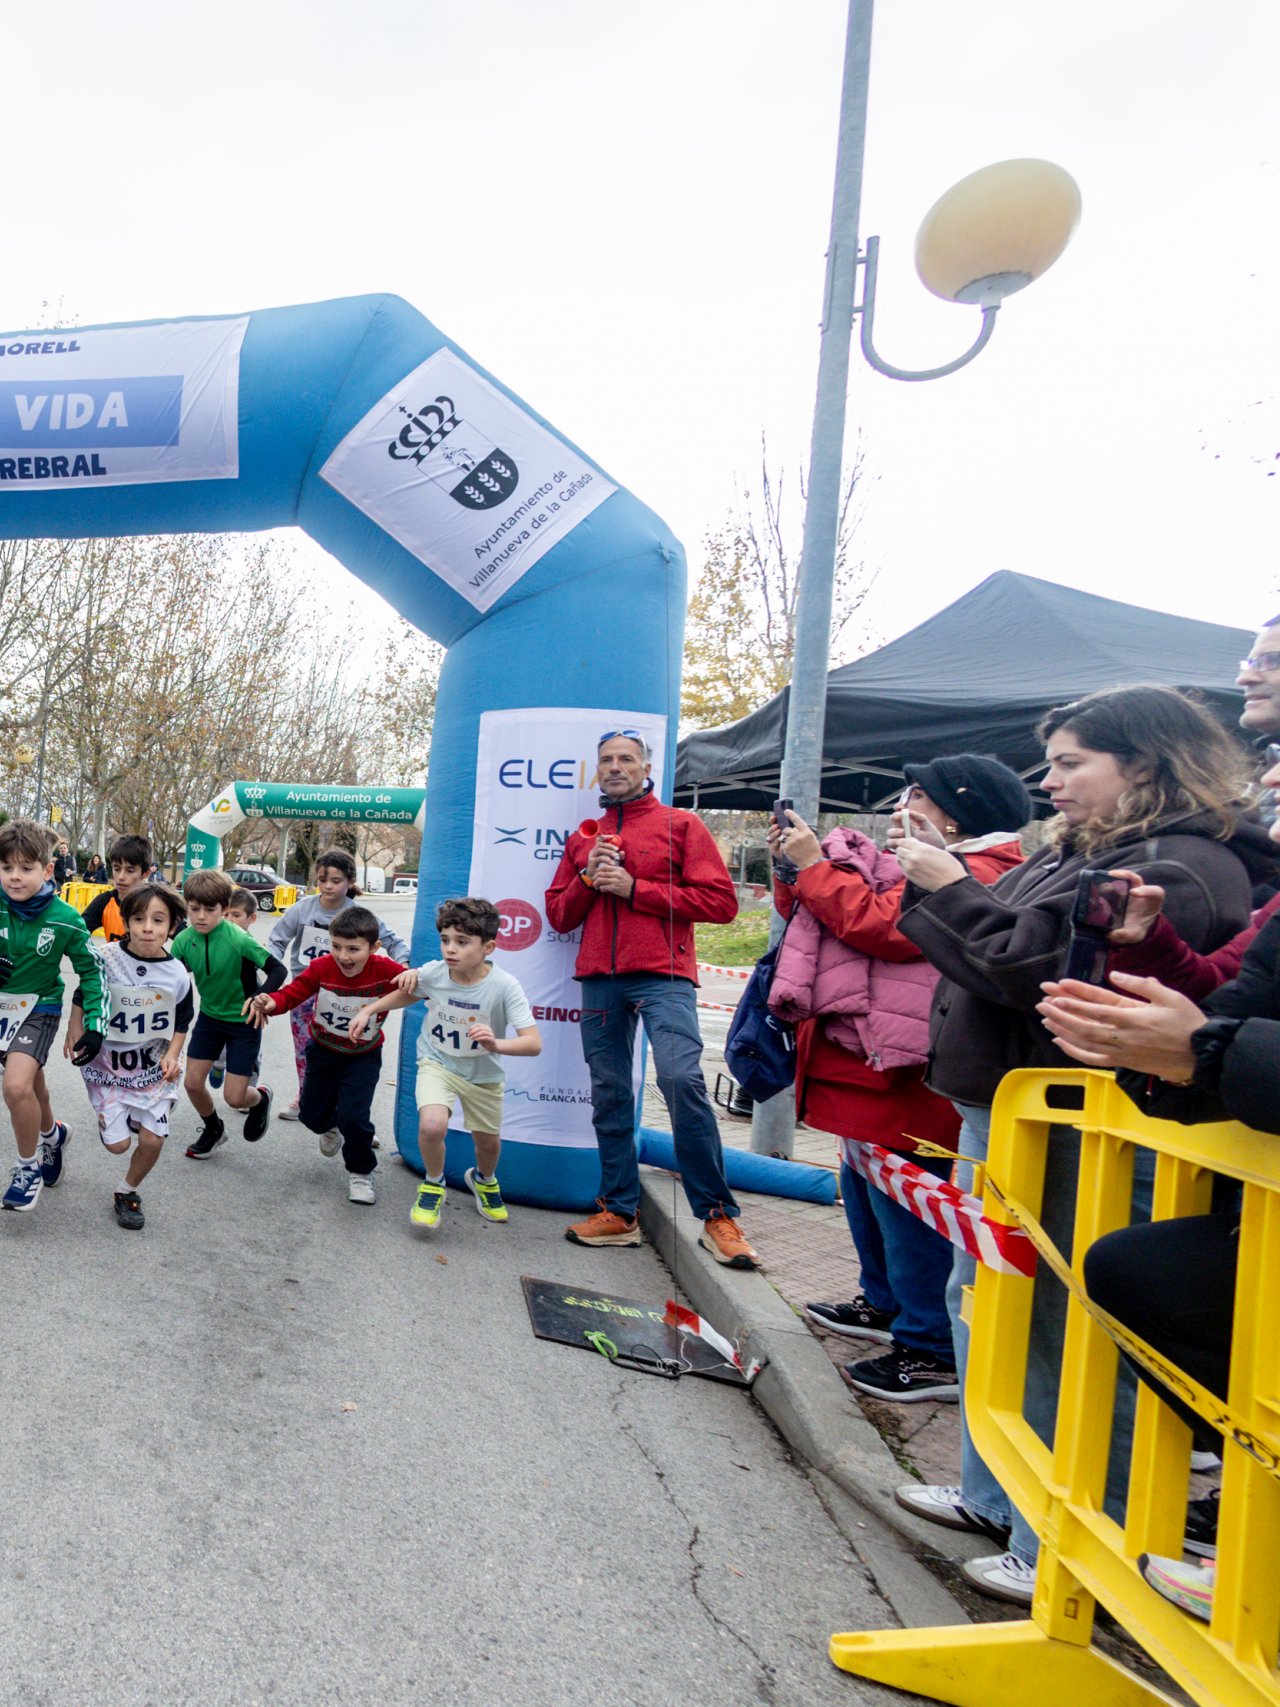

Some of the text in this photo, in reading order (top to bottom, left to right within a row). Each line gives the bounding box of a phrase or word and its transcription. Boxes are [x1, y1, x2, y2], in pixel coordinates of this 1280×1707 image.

[15, 390, 129, 431] VIDA
[474, 469, 567, 559] Ayuntamiento de
[469, 472, 593, 588] Villanueva de la Cañada
[286, 790, 391, 804] Ayuntamiento de
[266, 805, 413, 820] Villanueva de la Cañada
[498, 914, 531, 936] QP
[120, 997, 154, 1007] ELEIA
[332, 1003, 359, 1013] ELEIA
[109, 1011, 169, 1034] 415
[438, 1012, 467, 1024] ELEIA
[111, 1046, 157, 1071] 10K
[85, 1067, 103, 1079] POR
[540, 1093, 576, 1104] BLANCA
